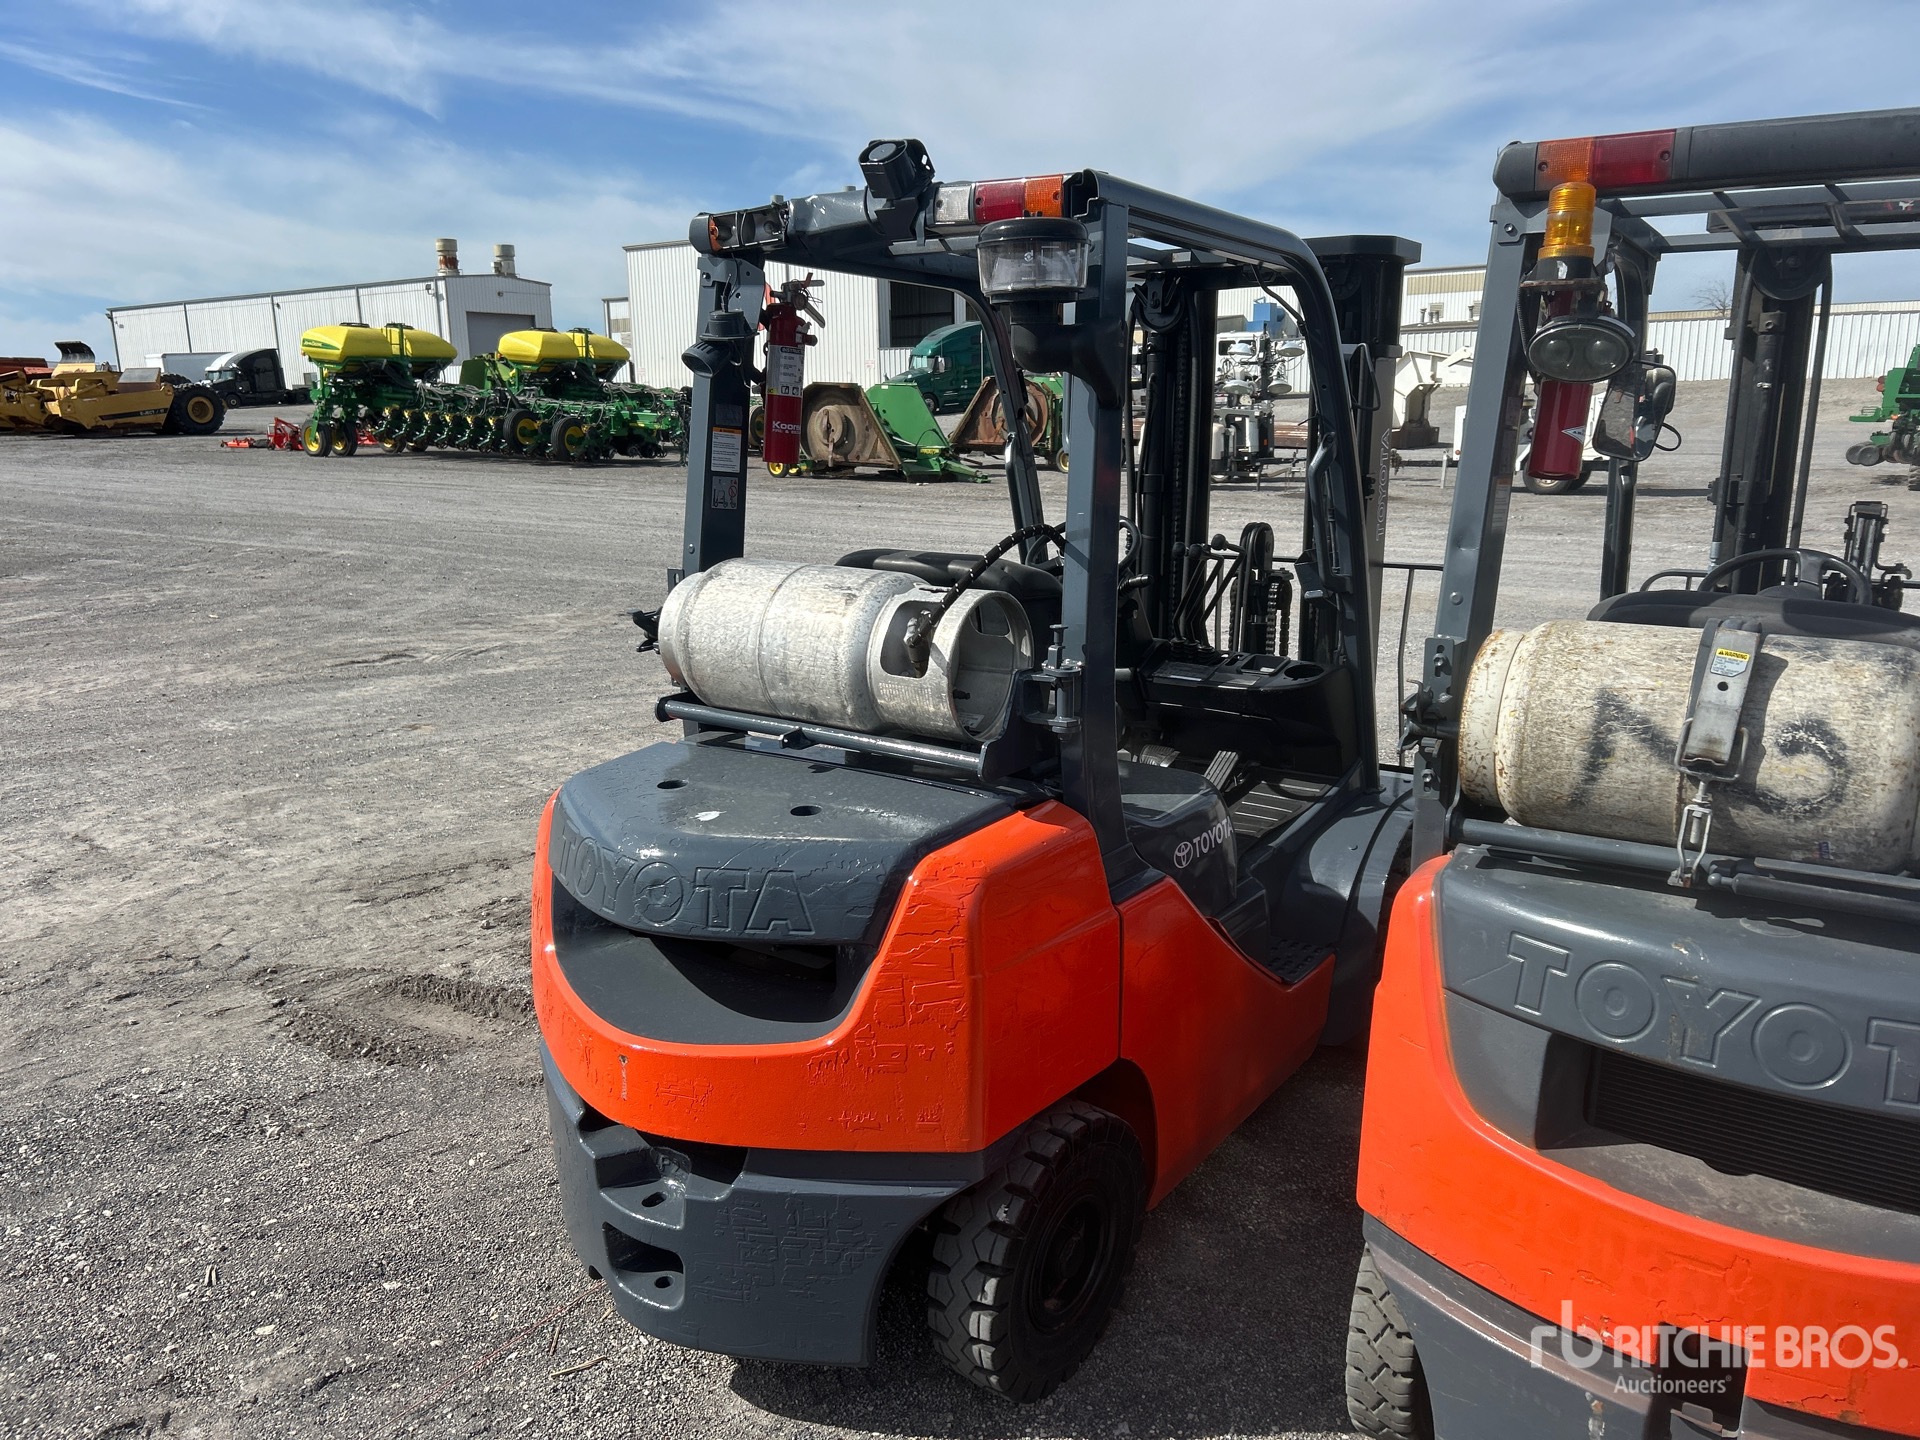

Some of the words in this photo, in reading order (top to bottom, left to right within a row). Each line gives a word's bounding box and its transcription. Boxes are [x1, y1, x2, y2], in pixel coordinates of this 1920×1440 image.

[1376, 428, 1390, 541] TOYOTA
[1725, 651, 1748, 660] WARNING
[1193, 816, 1233, 857] TOYOTA
[560, 820, 816, 936] TOYOTA
